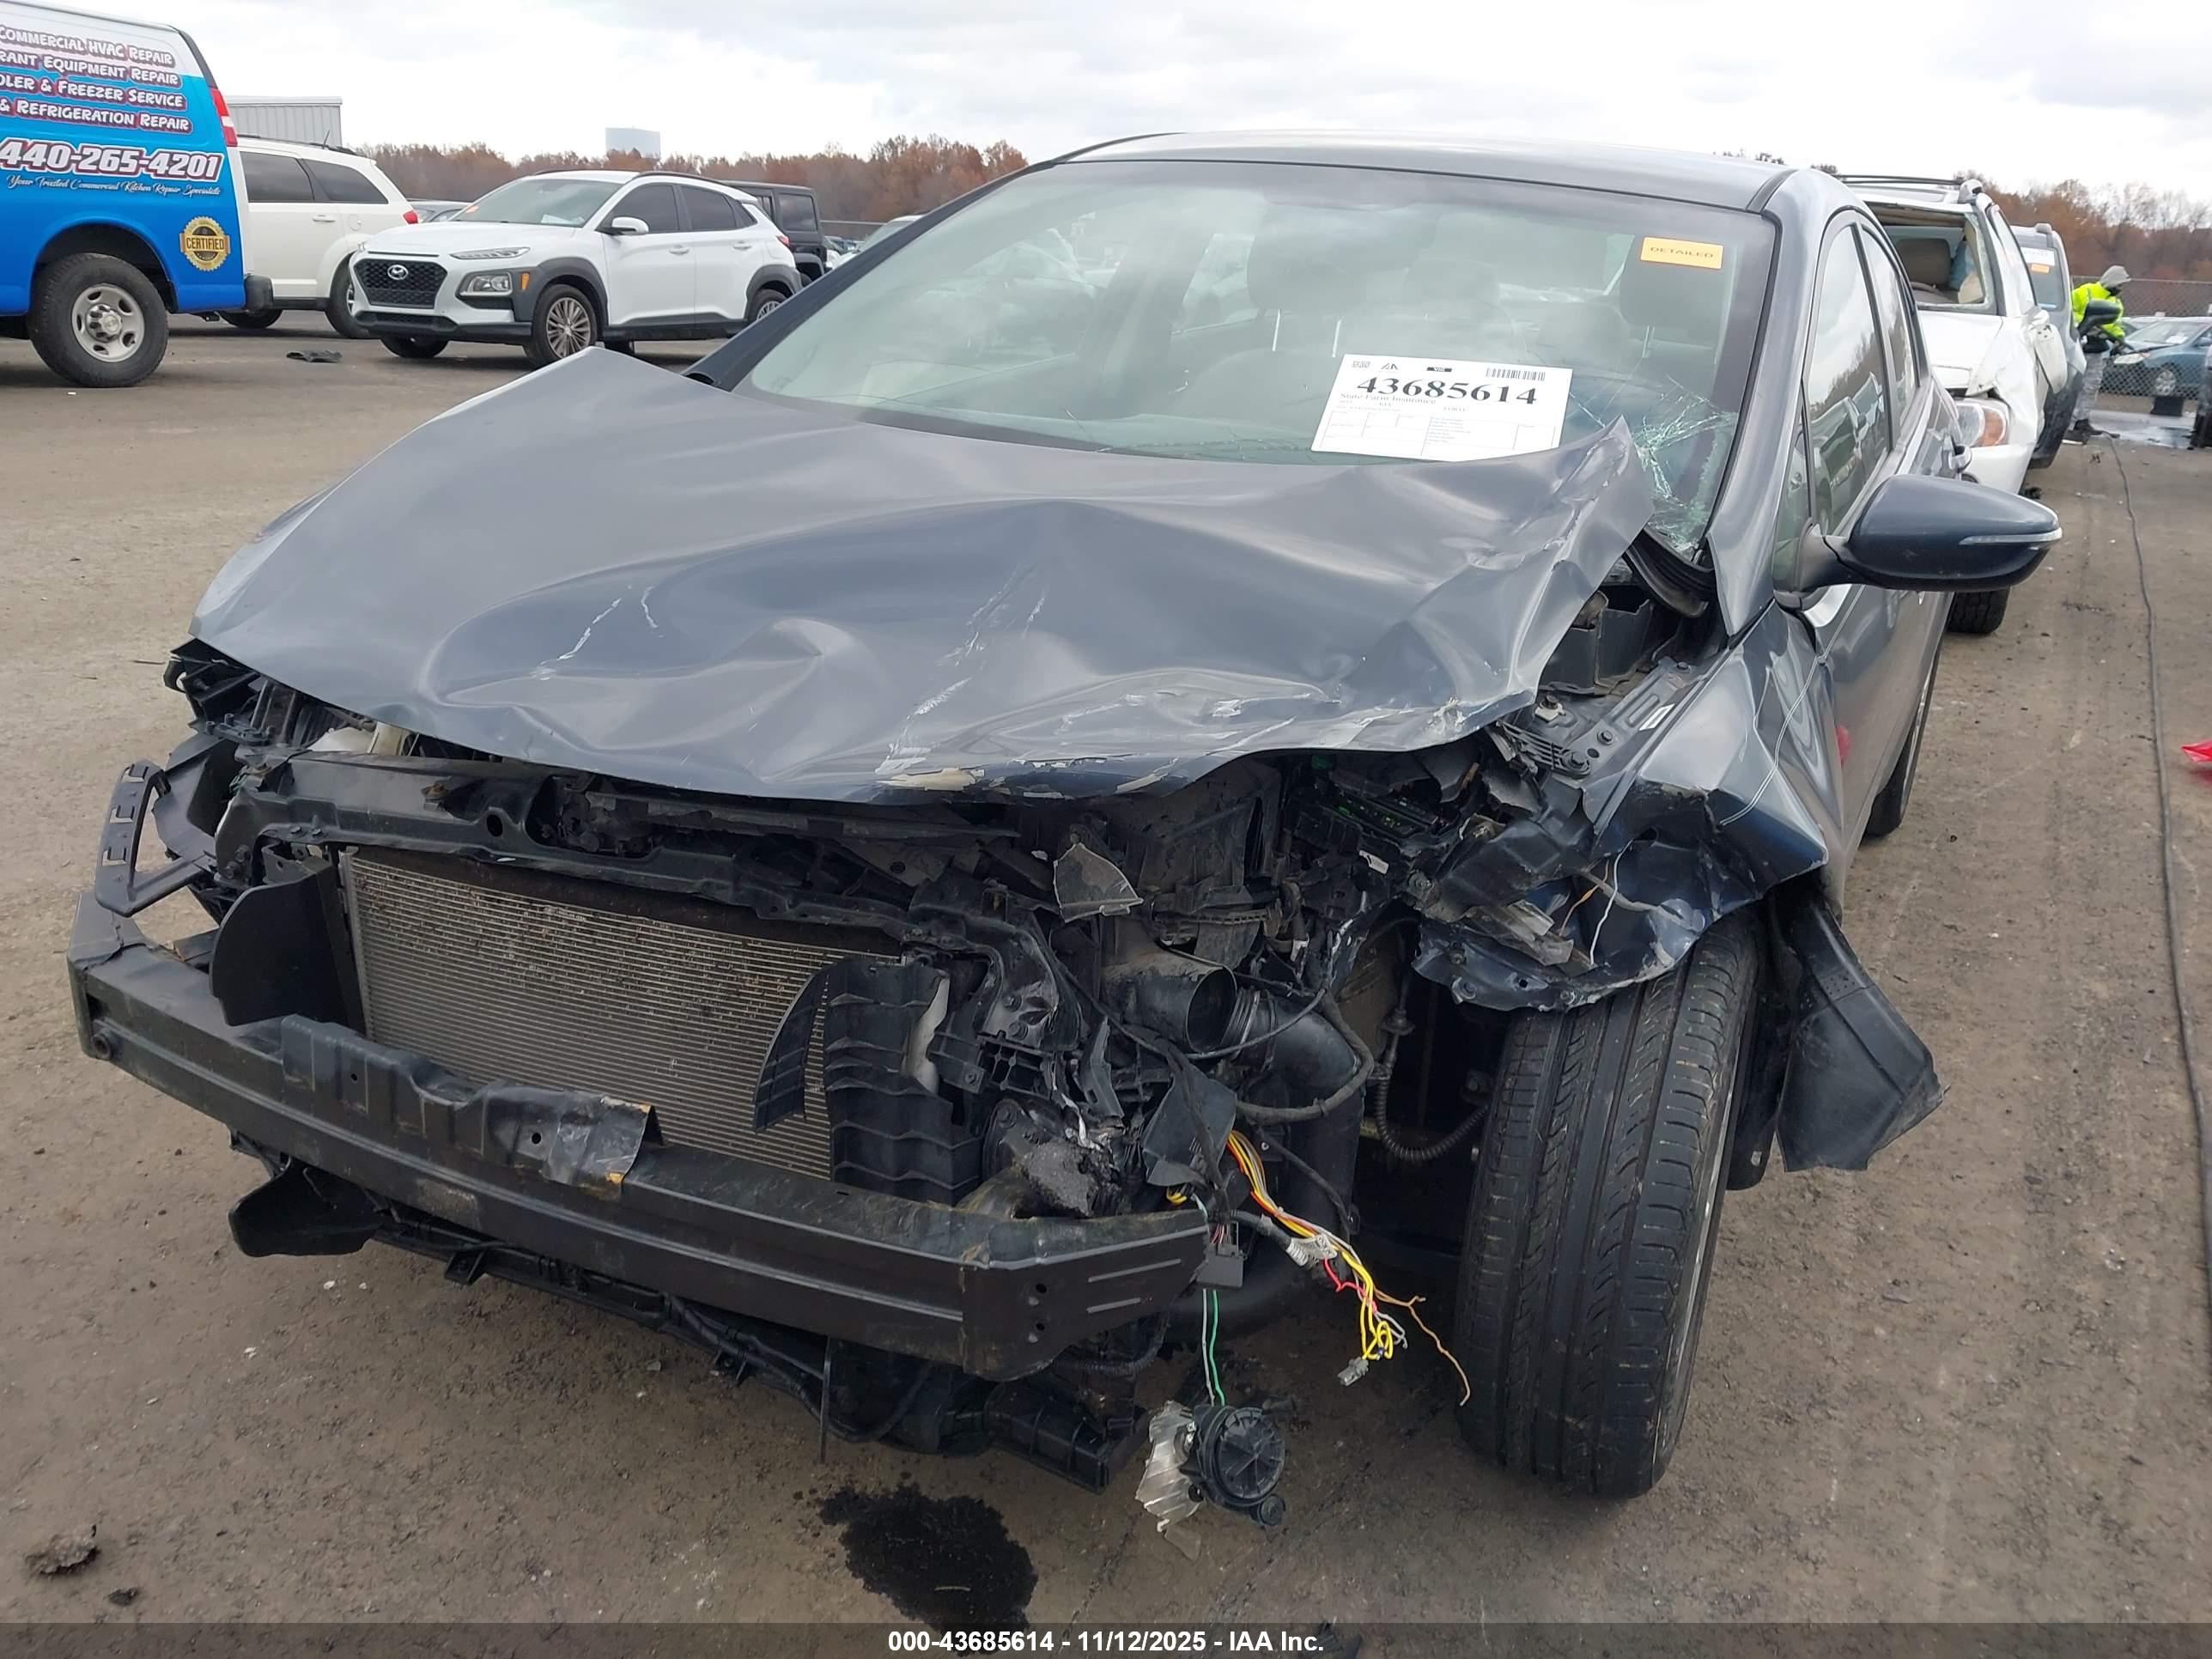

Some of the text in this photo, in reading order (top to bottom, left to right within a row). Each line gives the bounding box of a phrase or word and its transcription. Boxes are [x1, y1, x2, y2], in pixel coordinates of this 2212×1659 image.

[0, 26, 173, 64] COMMERCIAL HVAC REPAIR
[43, 56, 126, 78] EQUIPMENT
[131, 68, 179, 85] REPAIR
[40, 78, 52, 92] &
[58, 80, 125, 101] FREEZER
[128, 88, 183, 107] SERVICE
[17, 100, 135, 126] REFRIGERATION
[139, 112, 190, 131] REPAIR
[0, 140, 219, 178] 440-265-4201
[6, 174, 34, 189] Your
[35, 176, 69, 189] Trusted
[70, 179, 120, 191] Commercial
[120, 181, 151, 193] Kitchen
[152, 182, 181, 197] Repair
[185, 237, 224, 250] CERTIFIED
[1650, 246, 1715, 258] DETAILED
[1357, 376, 1537, 405] 43685614
